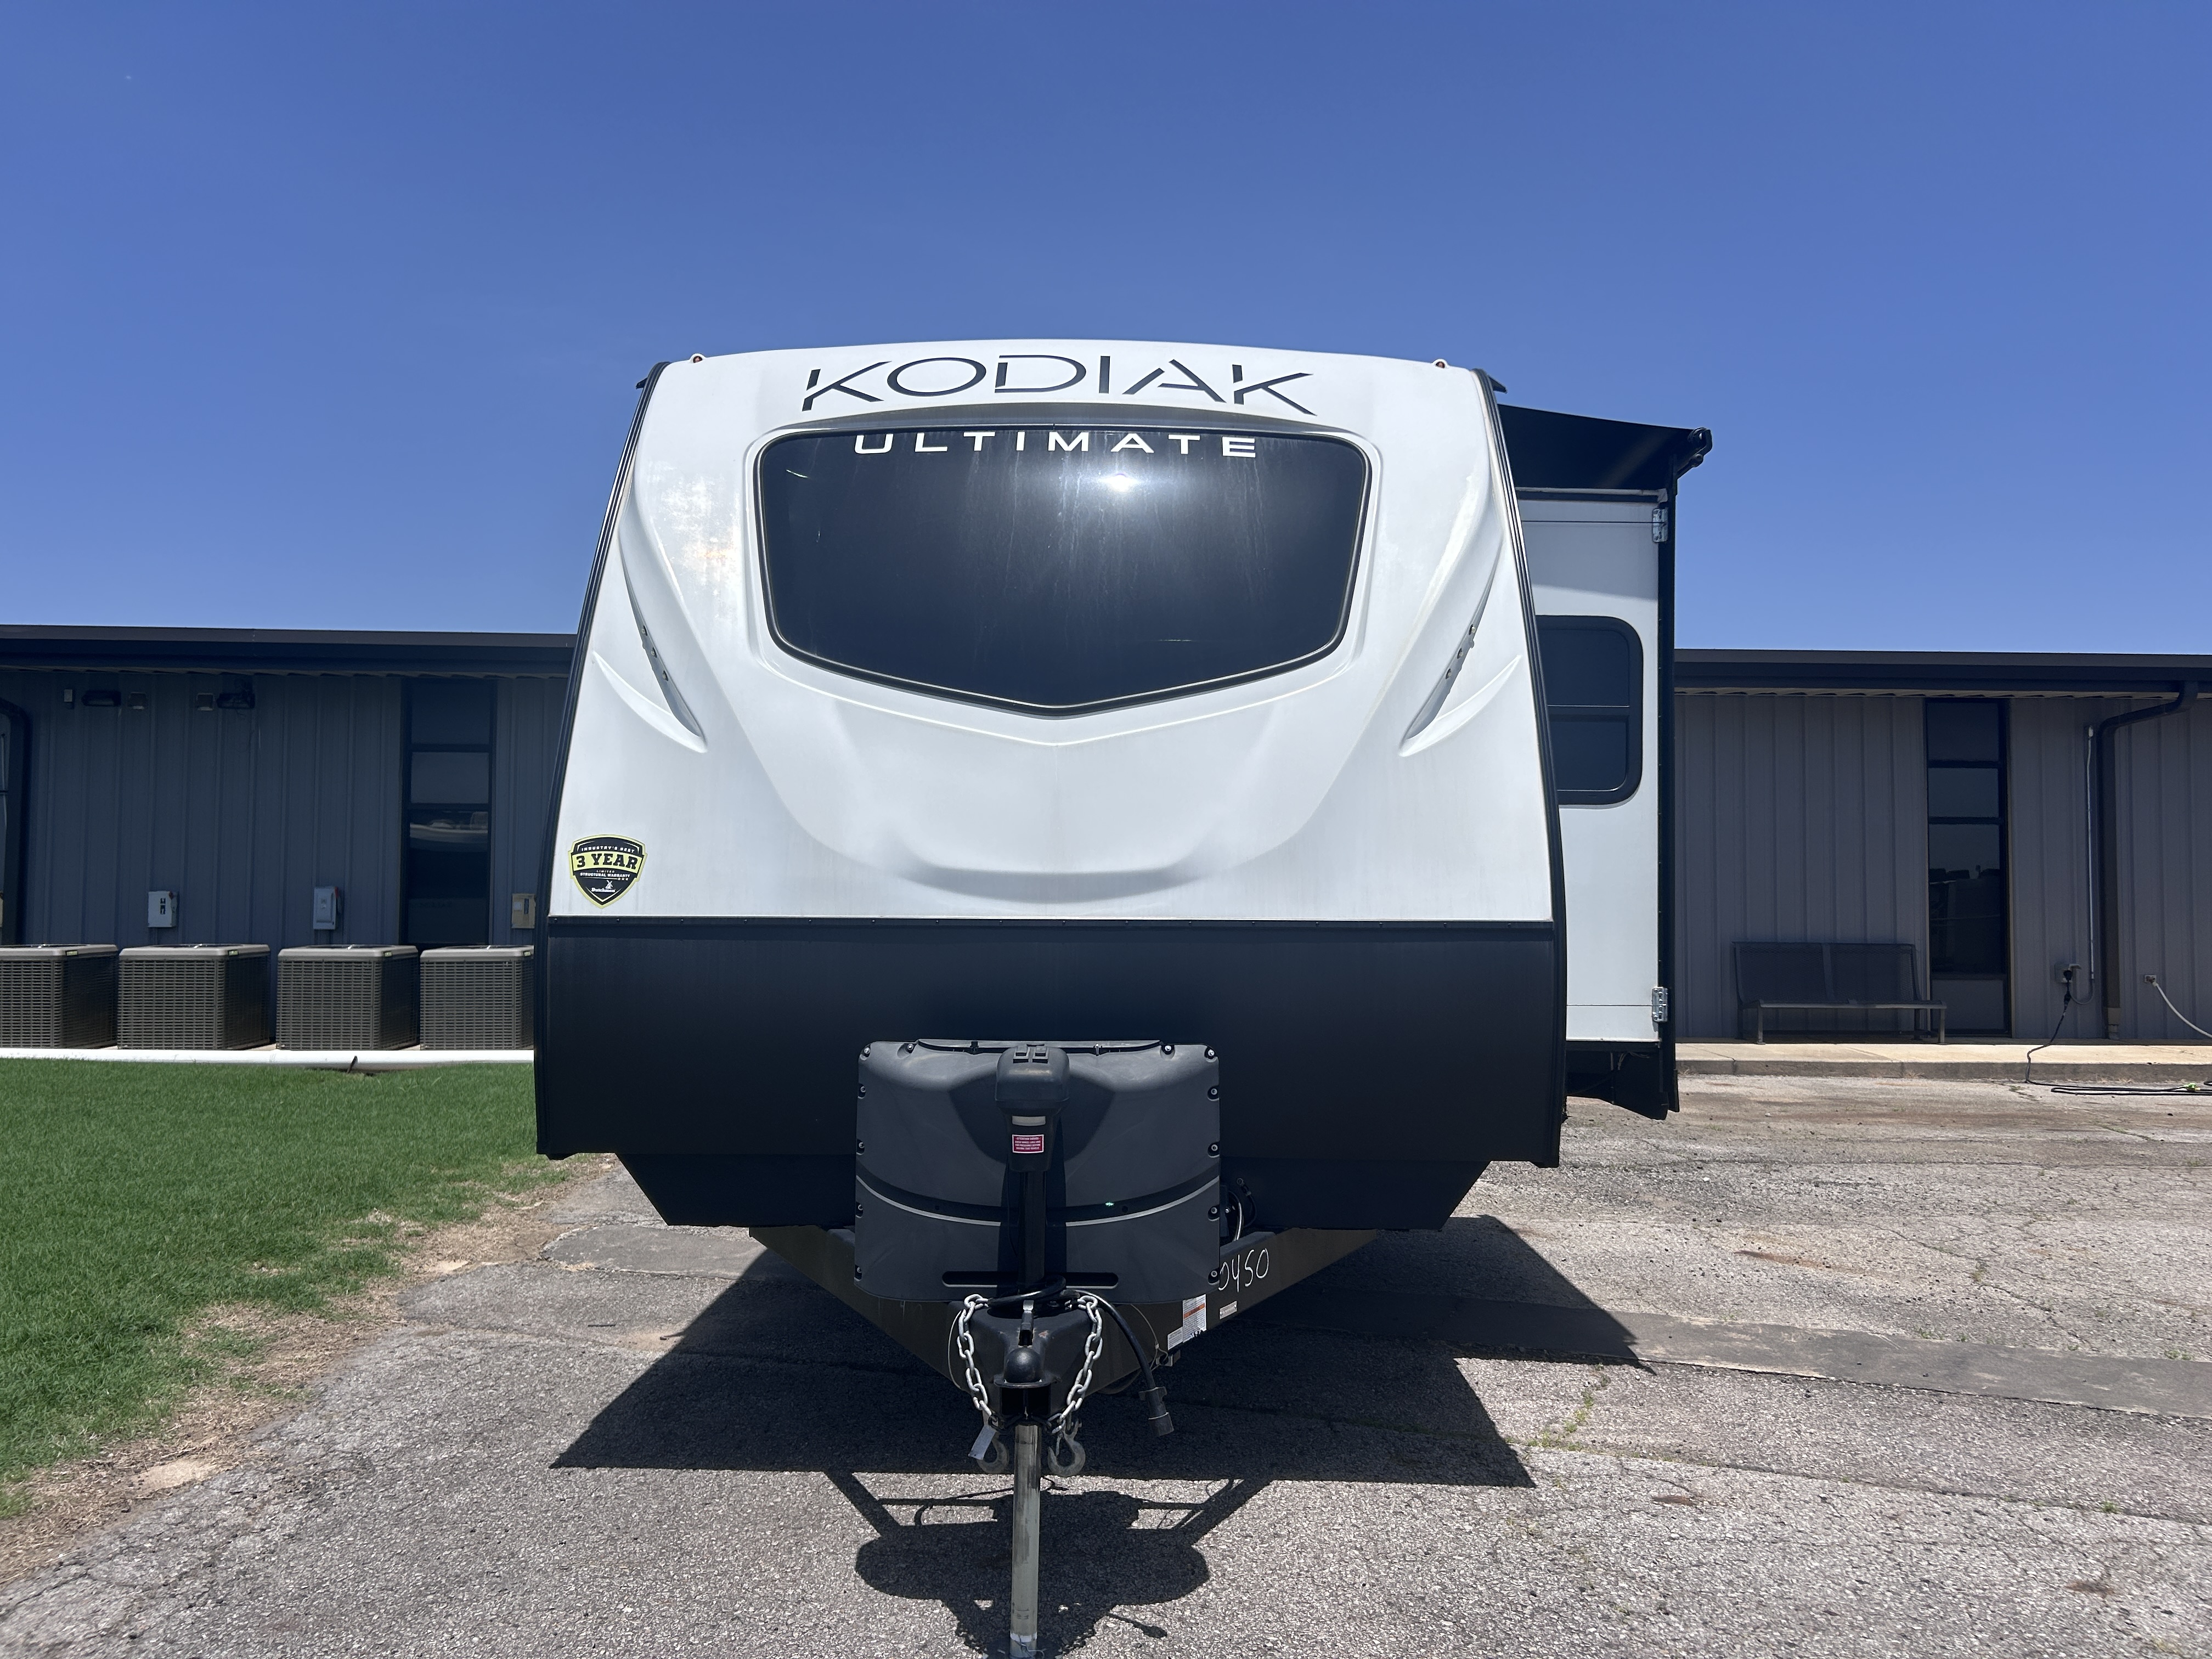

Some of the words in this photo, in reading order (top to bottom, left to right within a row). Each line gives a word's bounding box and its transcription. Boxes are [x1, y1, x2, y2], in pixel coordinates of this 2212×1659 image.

[802, 354, 1317, 416] KODIAK
[854, 431, 1256, 458] ULTIMATE
[576, 855, 585, 868] 3
[591, 853, 638, 870] YEAR
